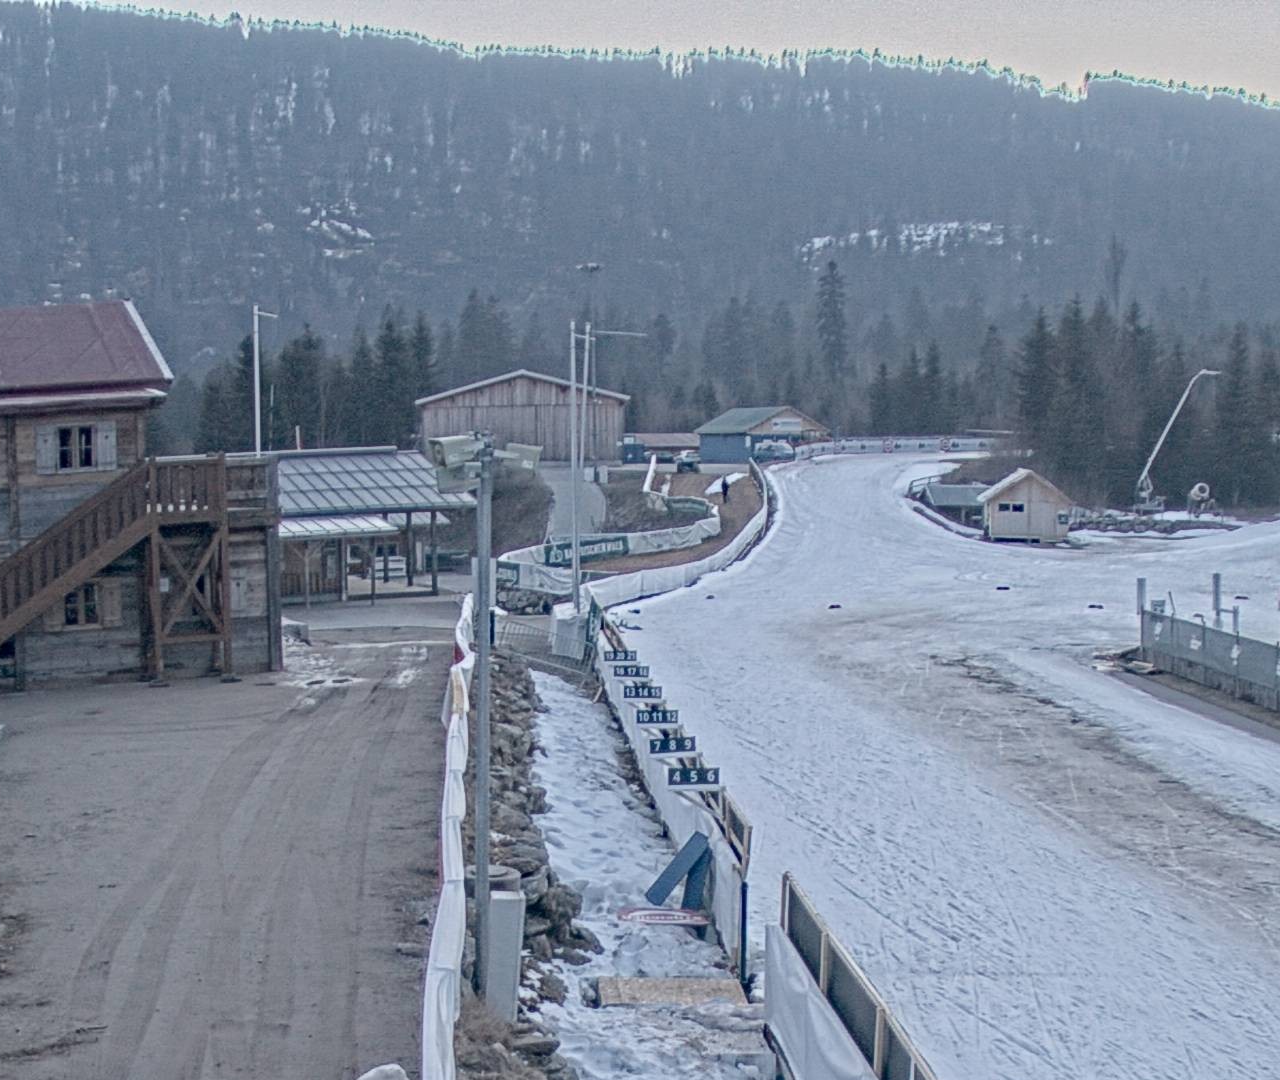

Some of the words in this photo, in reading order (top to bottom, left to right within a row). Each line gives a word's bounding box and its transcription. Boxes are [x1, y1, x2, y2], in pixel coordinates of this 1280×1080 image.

[626, 687, 636, 697] 13
[638, 687, 649, 697] 14
[651, 687, 660, 697] 15
[638, 711, 650, 722] 10
[652, 711, 663, 722] 11
[666, 711, 677, 722] 12
[654, 740, 661, 752] 7
[669, 740, 677, 751] 8
[684, 739, 692, 750] 9
[672, 770, 681, 783] 4
[689, 770, 698, 782] 5
[706, 769, 716, 783] 6
